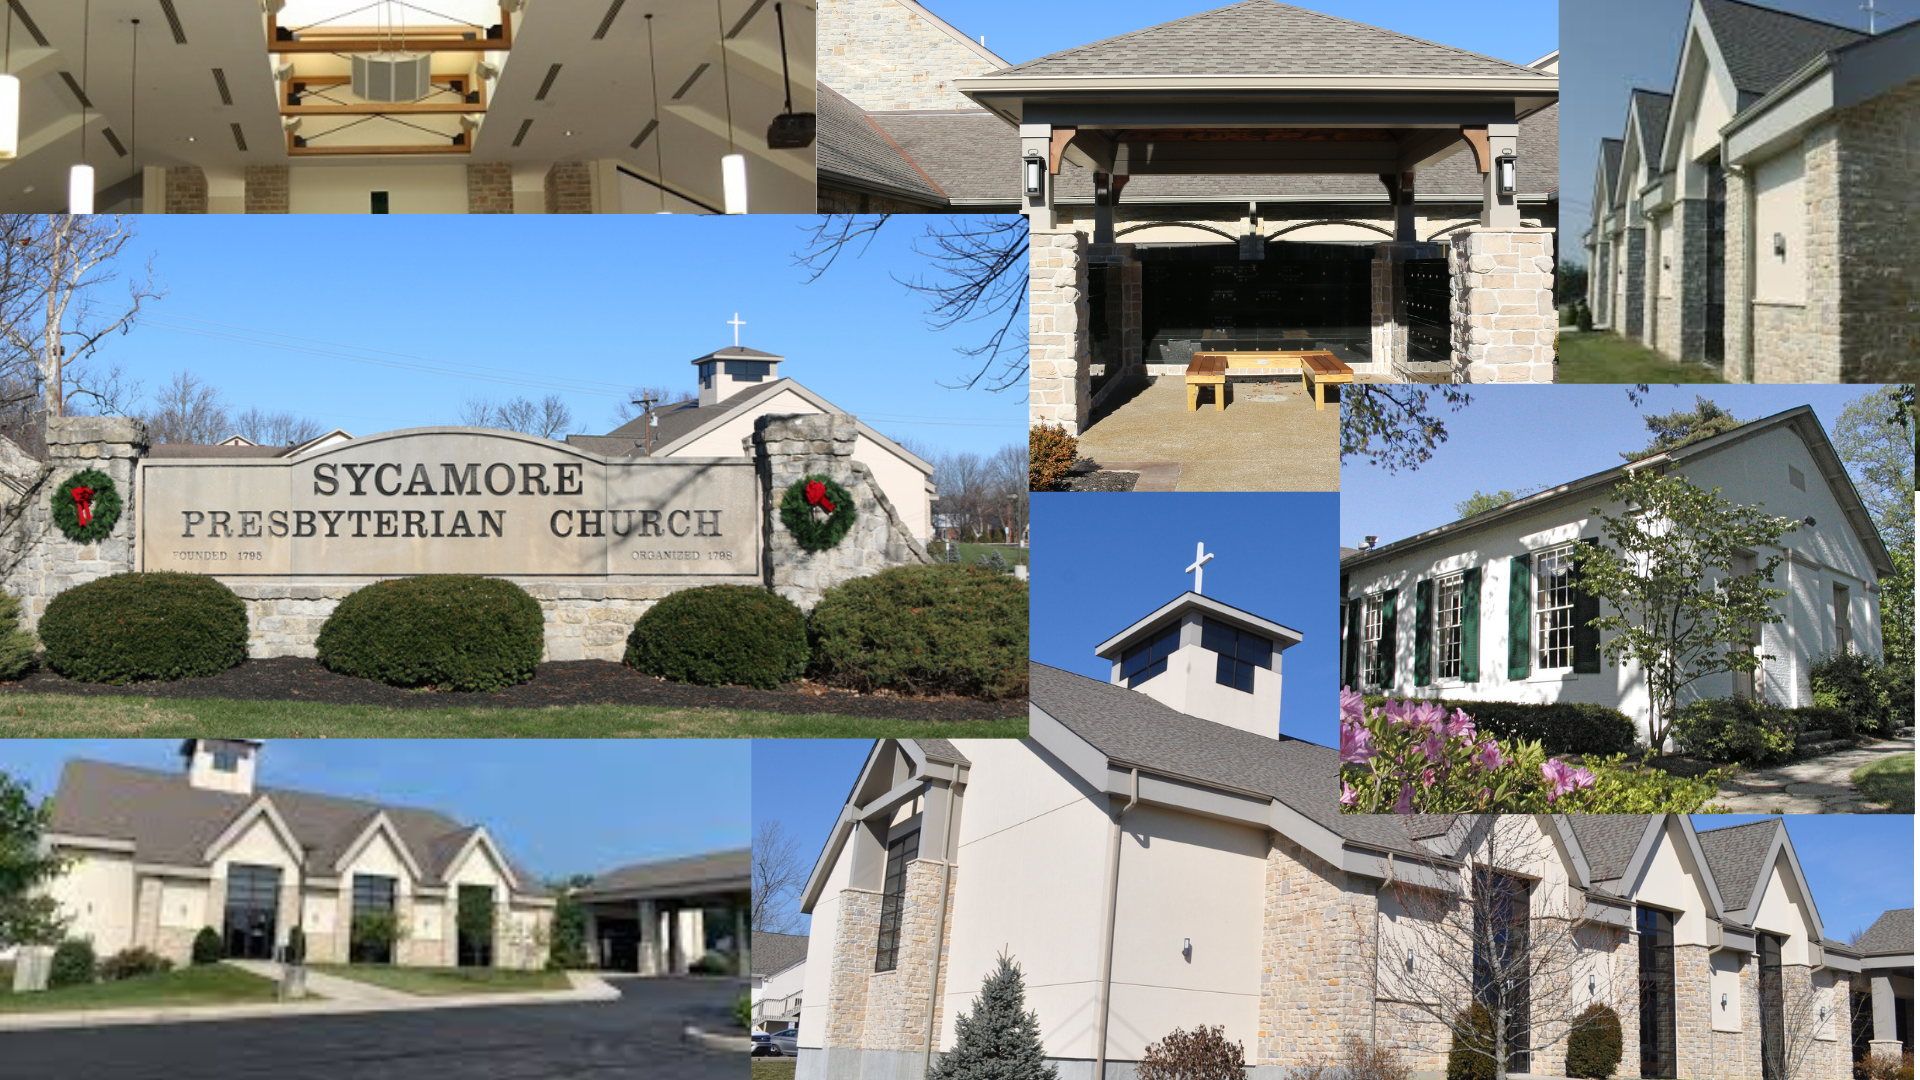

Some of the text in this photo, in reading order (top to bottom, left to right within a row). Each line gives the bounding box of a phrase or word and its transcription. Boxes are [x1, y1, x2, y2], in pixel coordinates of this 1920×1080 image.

[313, 462, 584, 497] SYCAMORE
[181, 510, 723, 539] PRESBYTERIAN CHURCH
[172, 551, 227, 561] FOUNDED
[631, 550, 733, 561] ORGANIZED 1798
